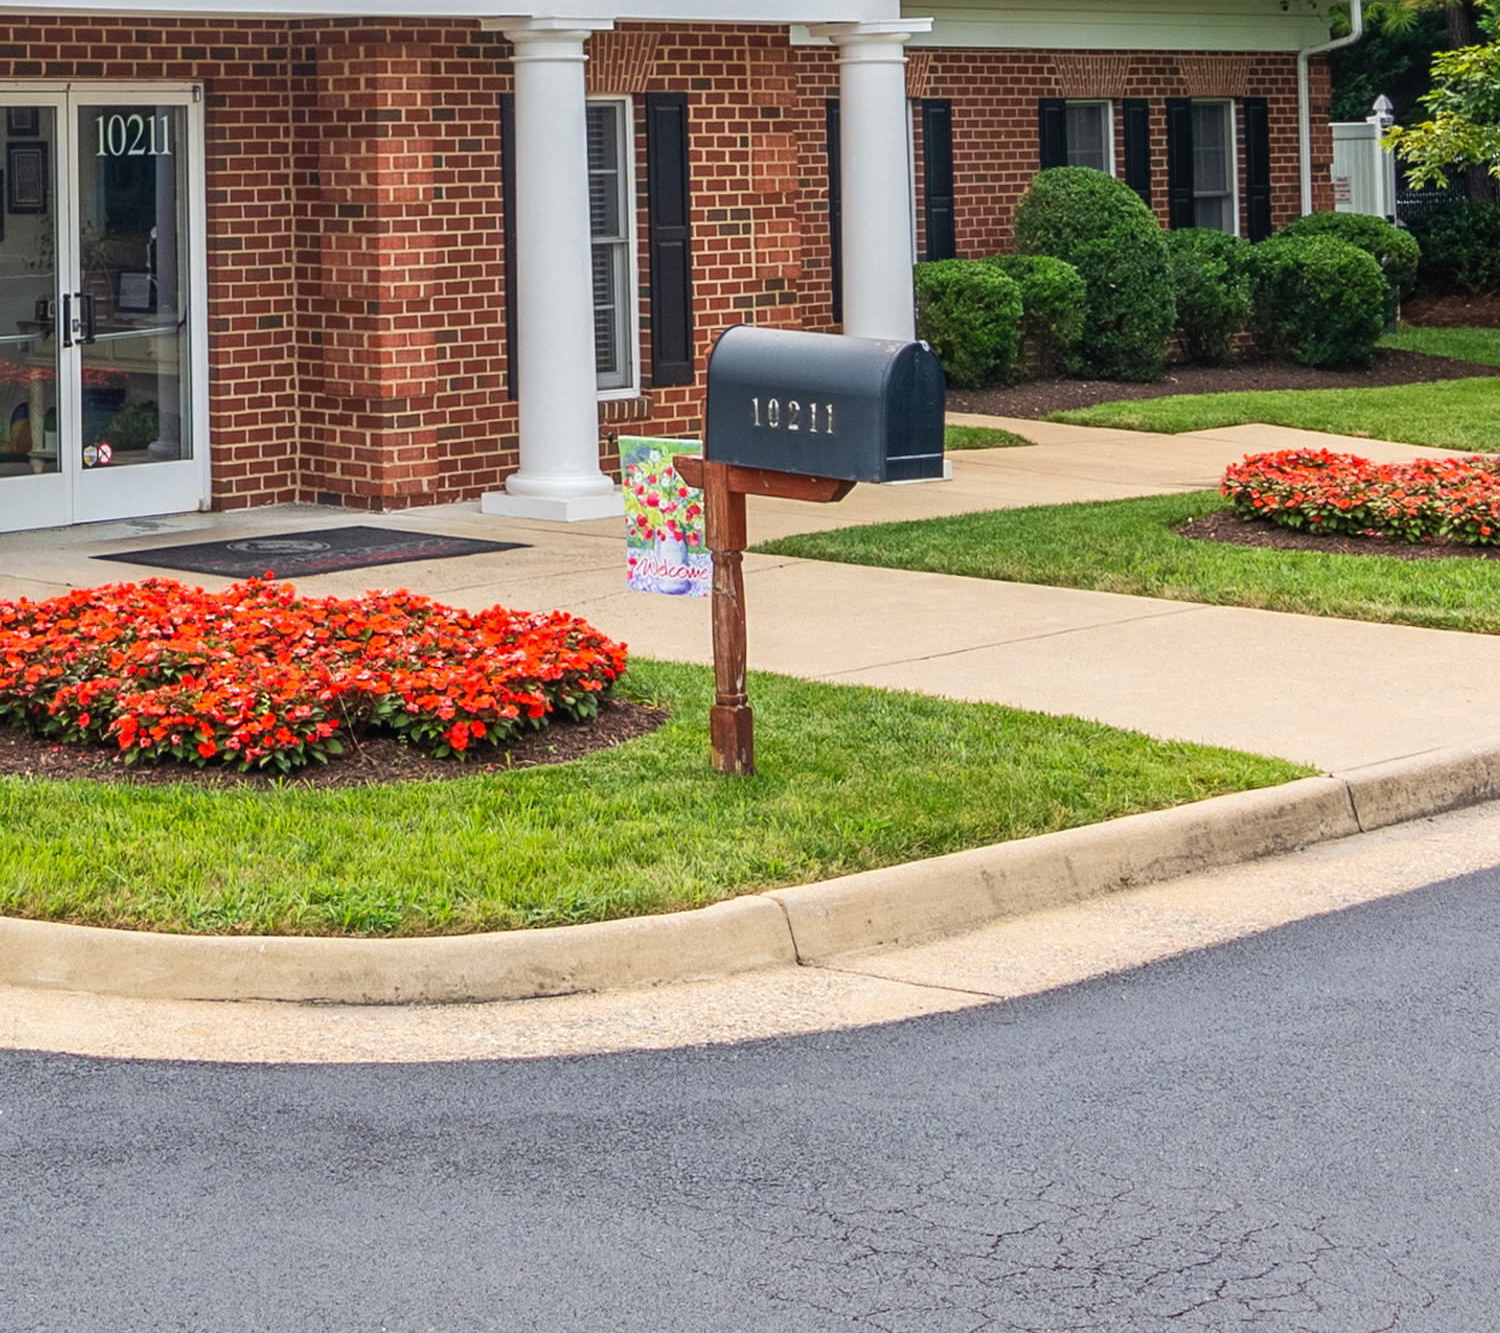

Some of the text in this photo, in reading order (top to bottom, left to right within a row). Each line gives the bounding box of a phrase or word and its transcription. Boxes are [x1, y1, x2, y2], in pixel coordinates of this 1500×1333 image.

[95, 114, 173, 156] 10211
[752, 397, 834, 434] 10211
[635, 554, 709, 580] Welcome
